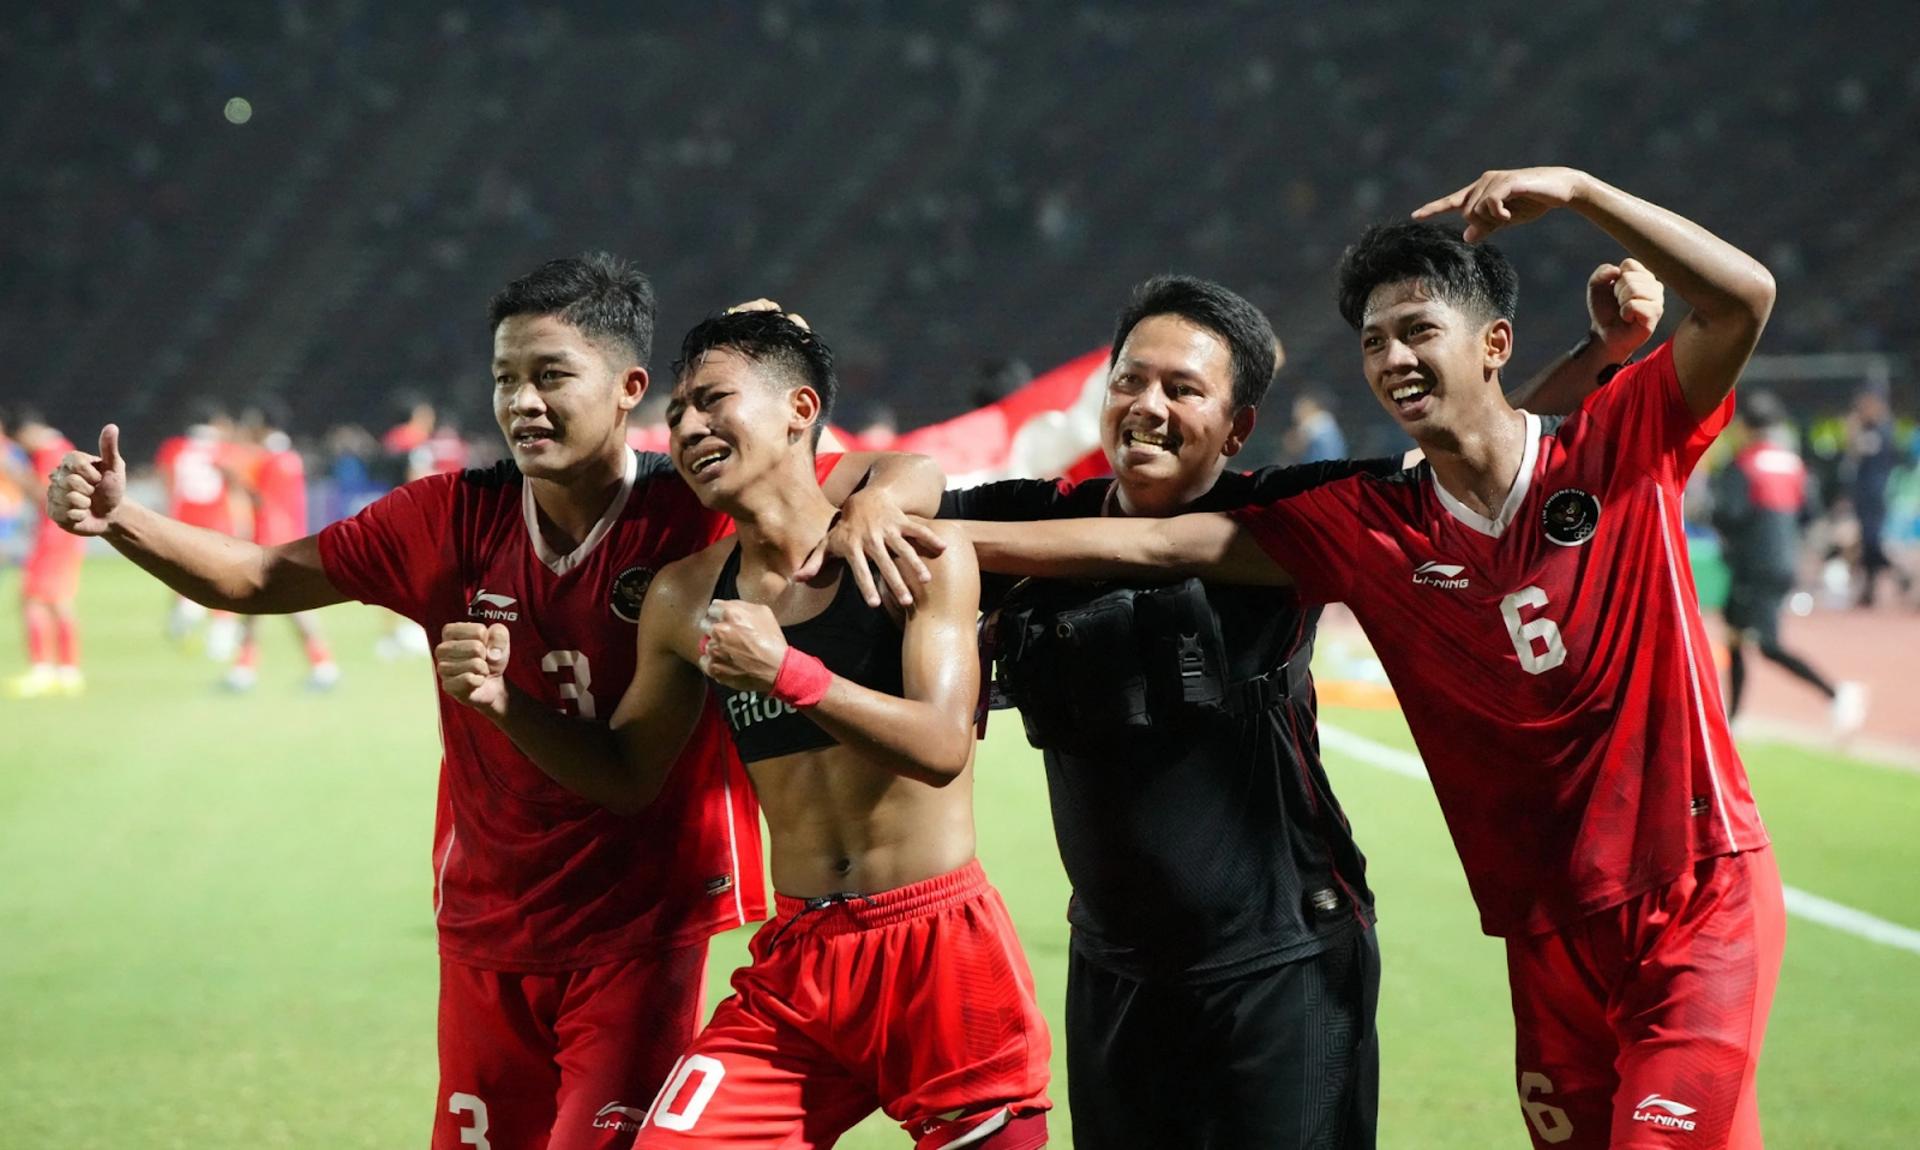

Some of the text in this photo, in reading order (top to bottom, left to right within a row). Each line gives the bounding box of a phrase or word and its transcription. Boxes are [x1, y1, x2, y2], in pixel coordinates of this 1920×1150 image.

[1412, 573, 1469, 589] LI-NING
[467, 607, 518, 621] LI-NING
[1499, 585, 1567, 675] 6
[542, 650, 596, 718] 3
[449, 1092, 491, 1150] 3
[640, 1053, 727, 1132] 0
[1520, 1071, 1574, 1144] 6
[1632, 1110, 1697, 1131] LI-NING
